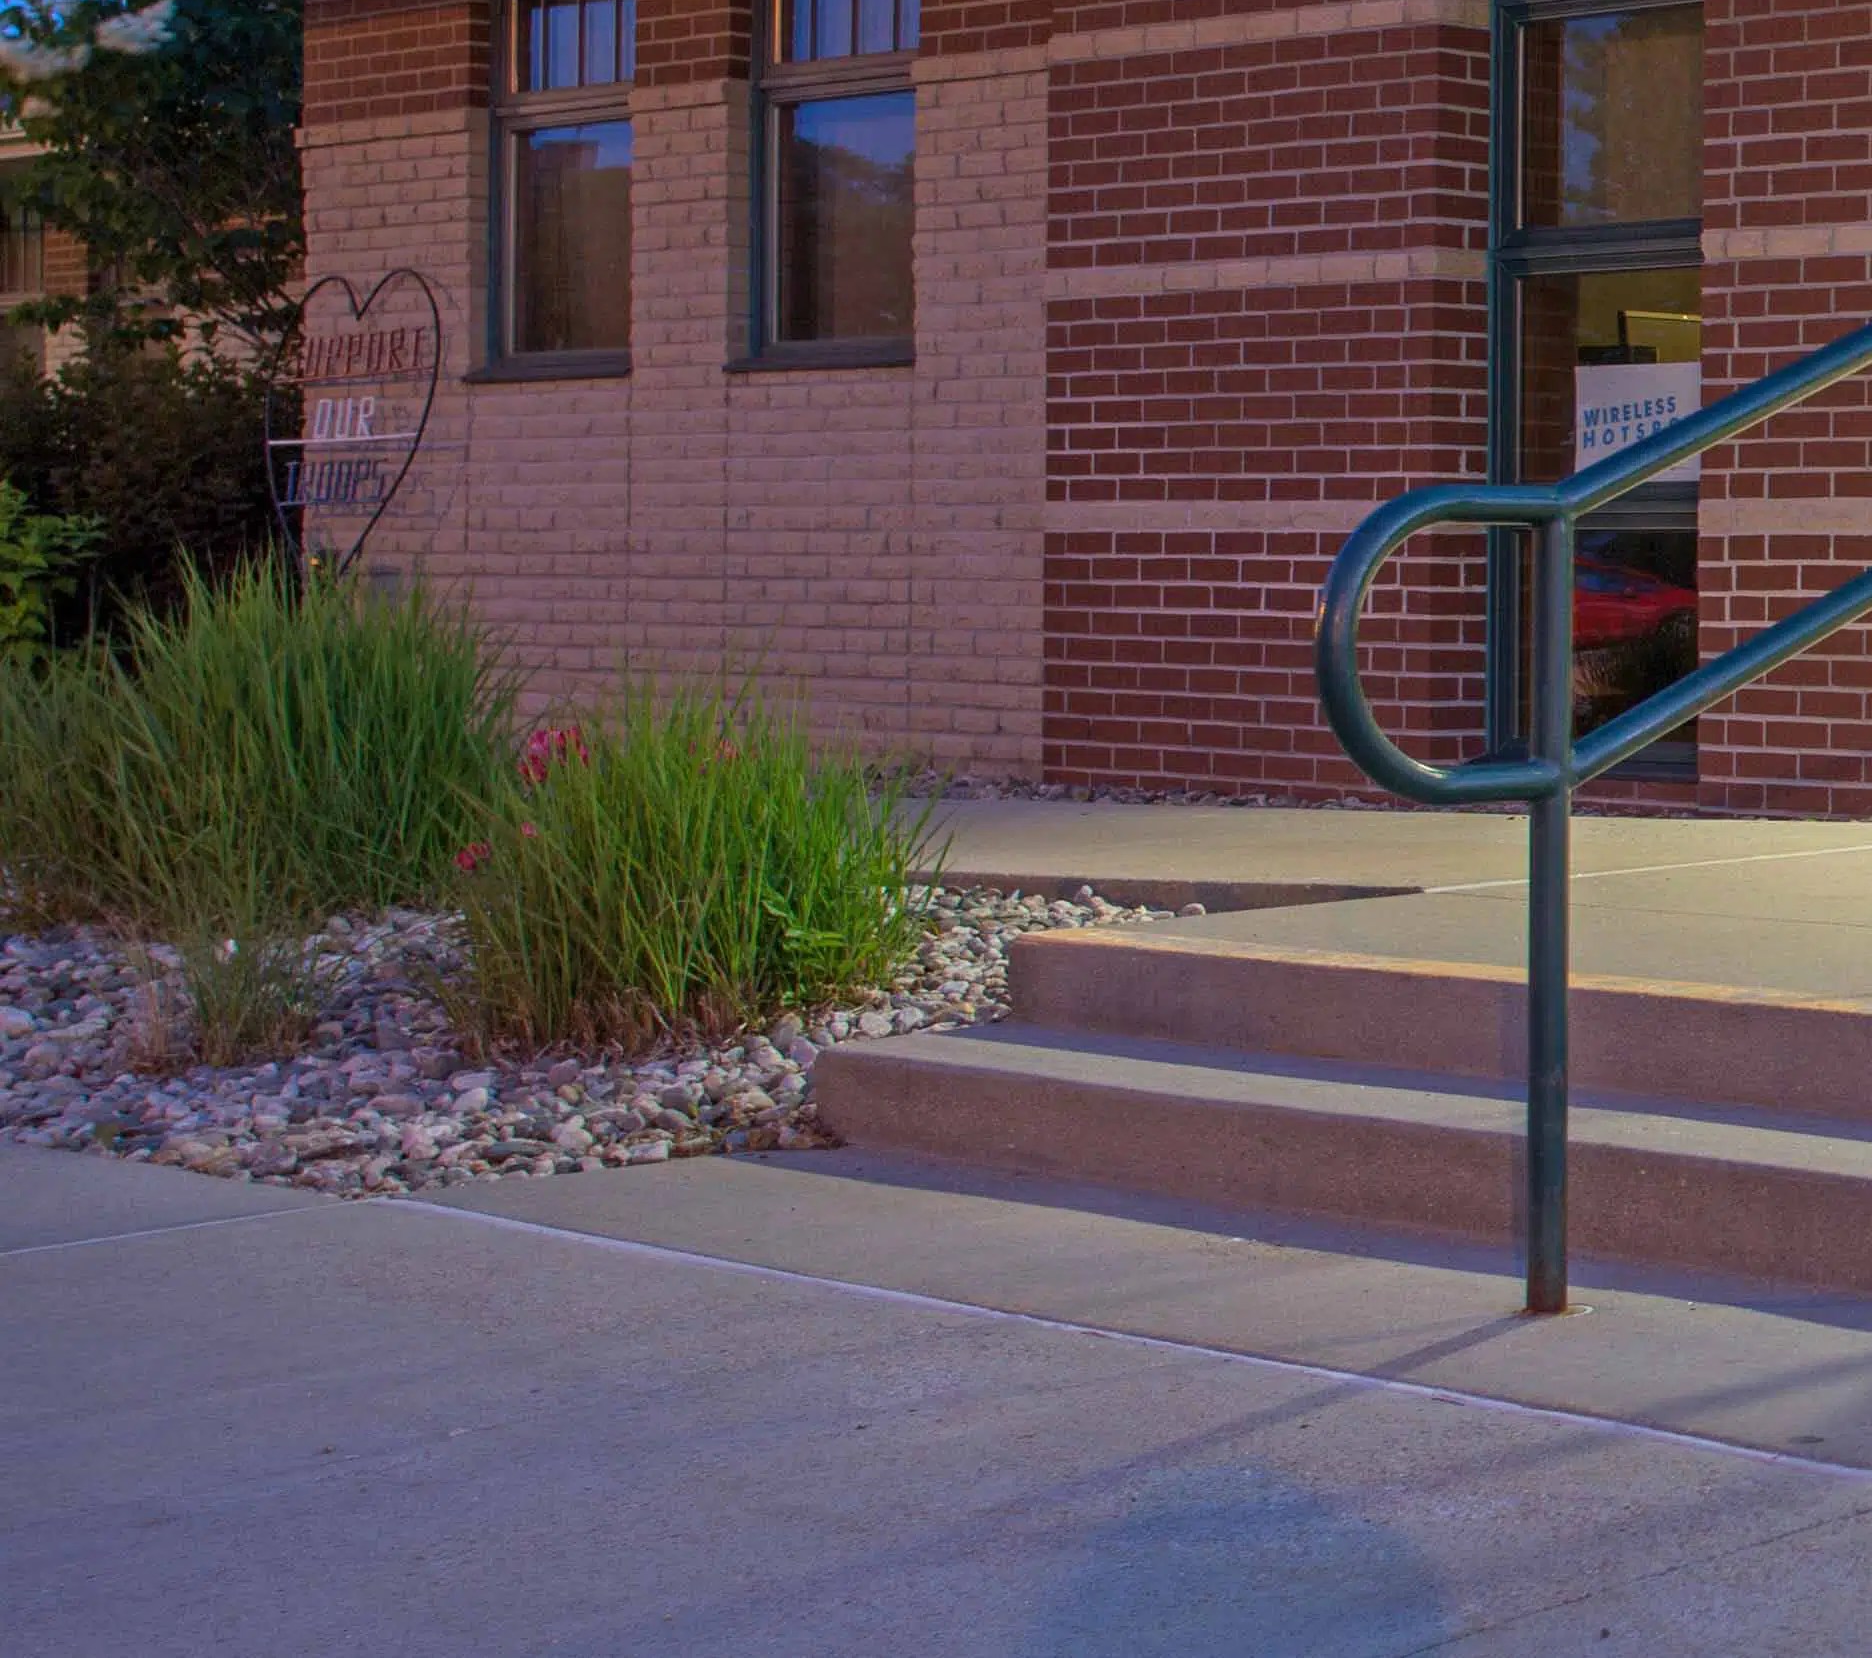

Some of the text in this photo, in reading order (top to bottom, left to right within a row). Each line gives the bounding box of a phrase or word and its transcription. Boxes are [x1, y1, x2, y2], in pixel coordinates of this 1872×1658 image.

[286, 326, 426, 378] UPPORT
[313, 396, 375, 440] OUR
[1583, 395, 1677, 428] WIRELESS
[1583, 417, 1679, 449] HOTSP
[284, 458, 390, 504] TROOPS
